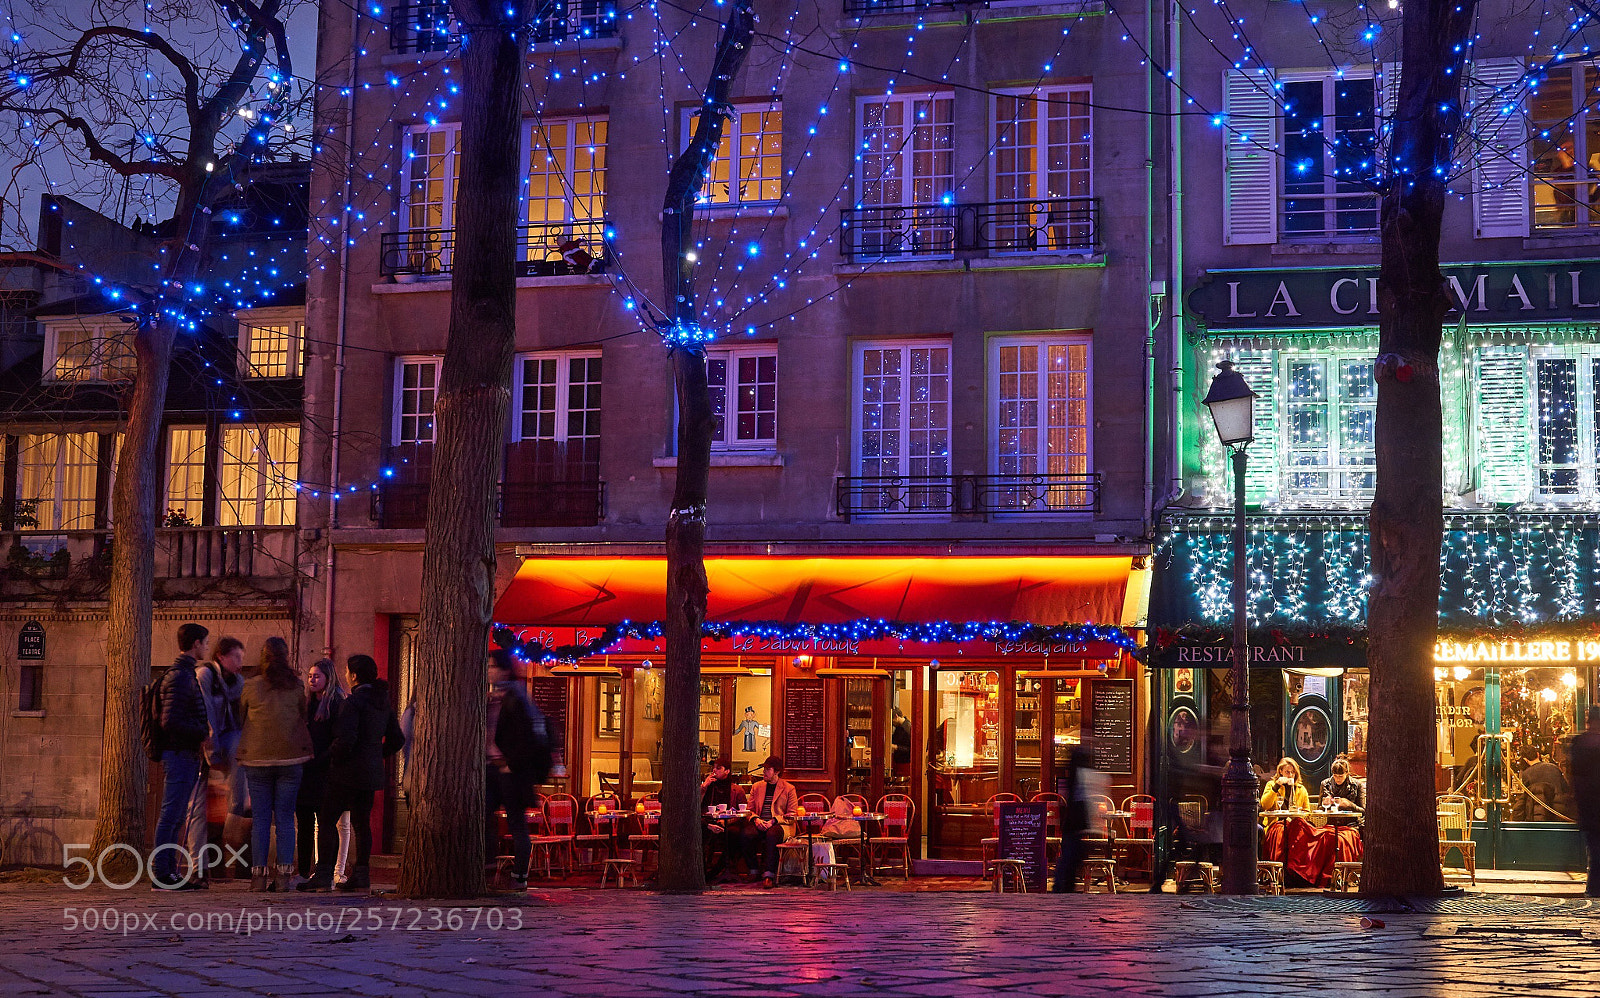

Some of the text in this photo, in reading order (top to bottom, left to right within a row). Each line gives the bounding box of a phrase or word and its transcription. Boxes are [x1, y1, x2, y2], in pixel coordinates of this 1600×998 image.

[1226, 269, 1600, 319] LA CMAIL
[732, 634, 755, 651] Le
[1577, 642, 1600, 661] 19
[1177, 646, 1305, 662] RESTARANT
